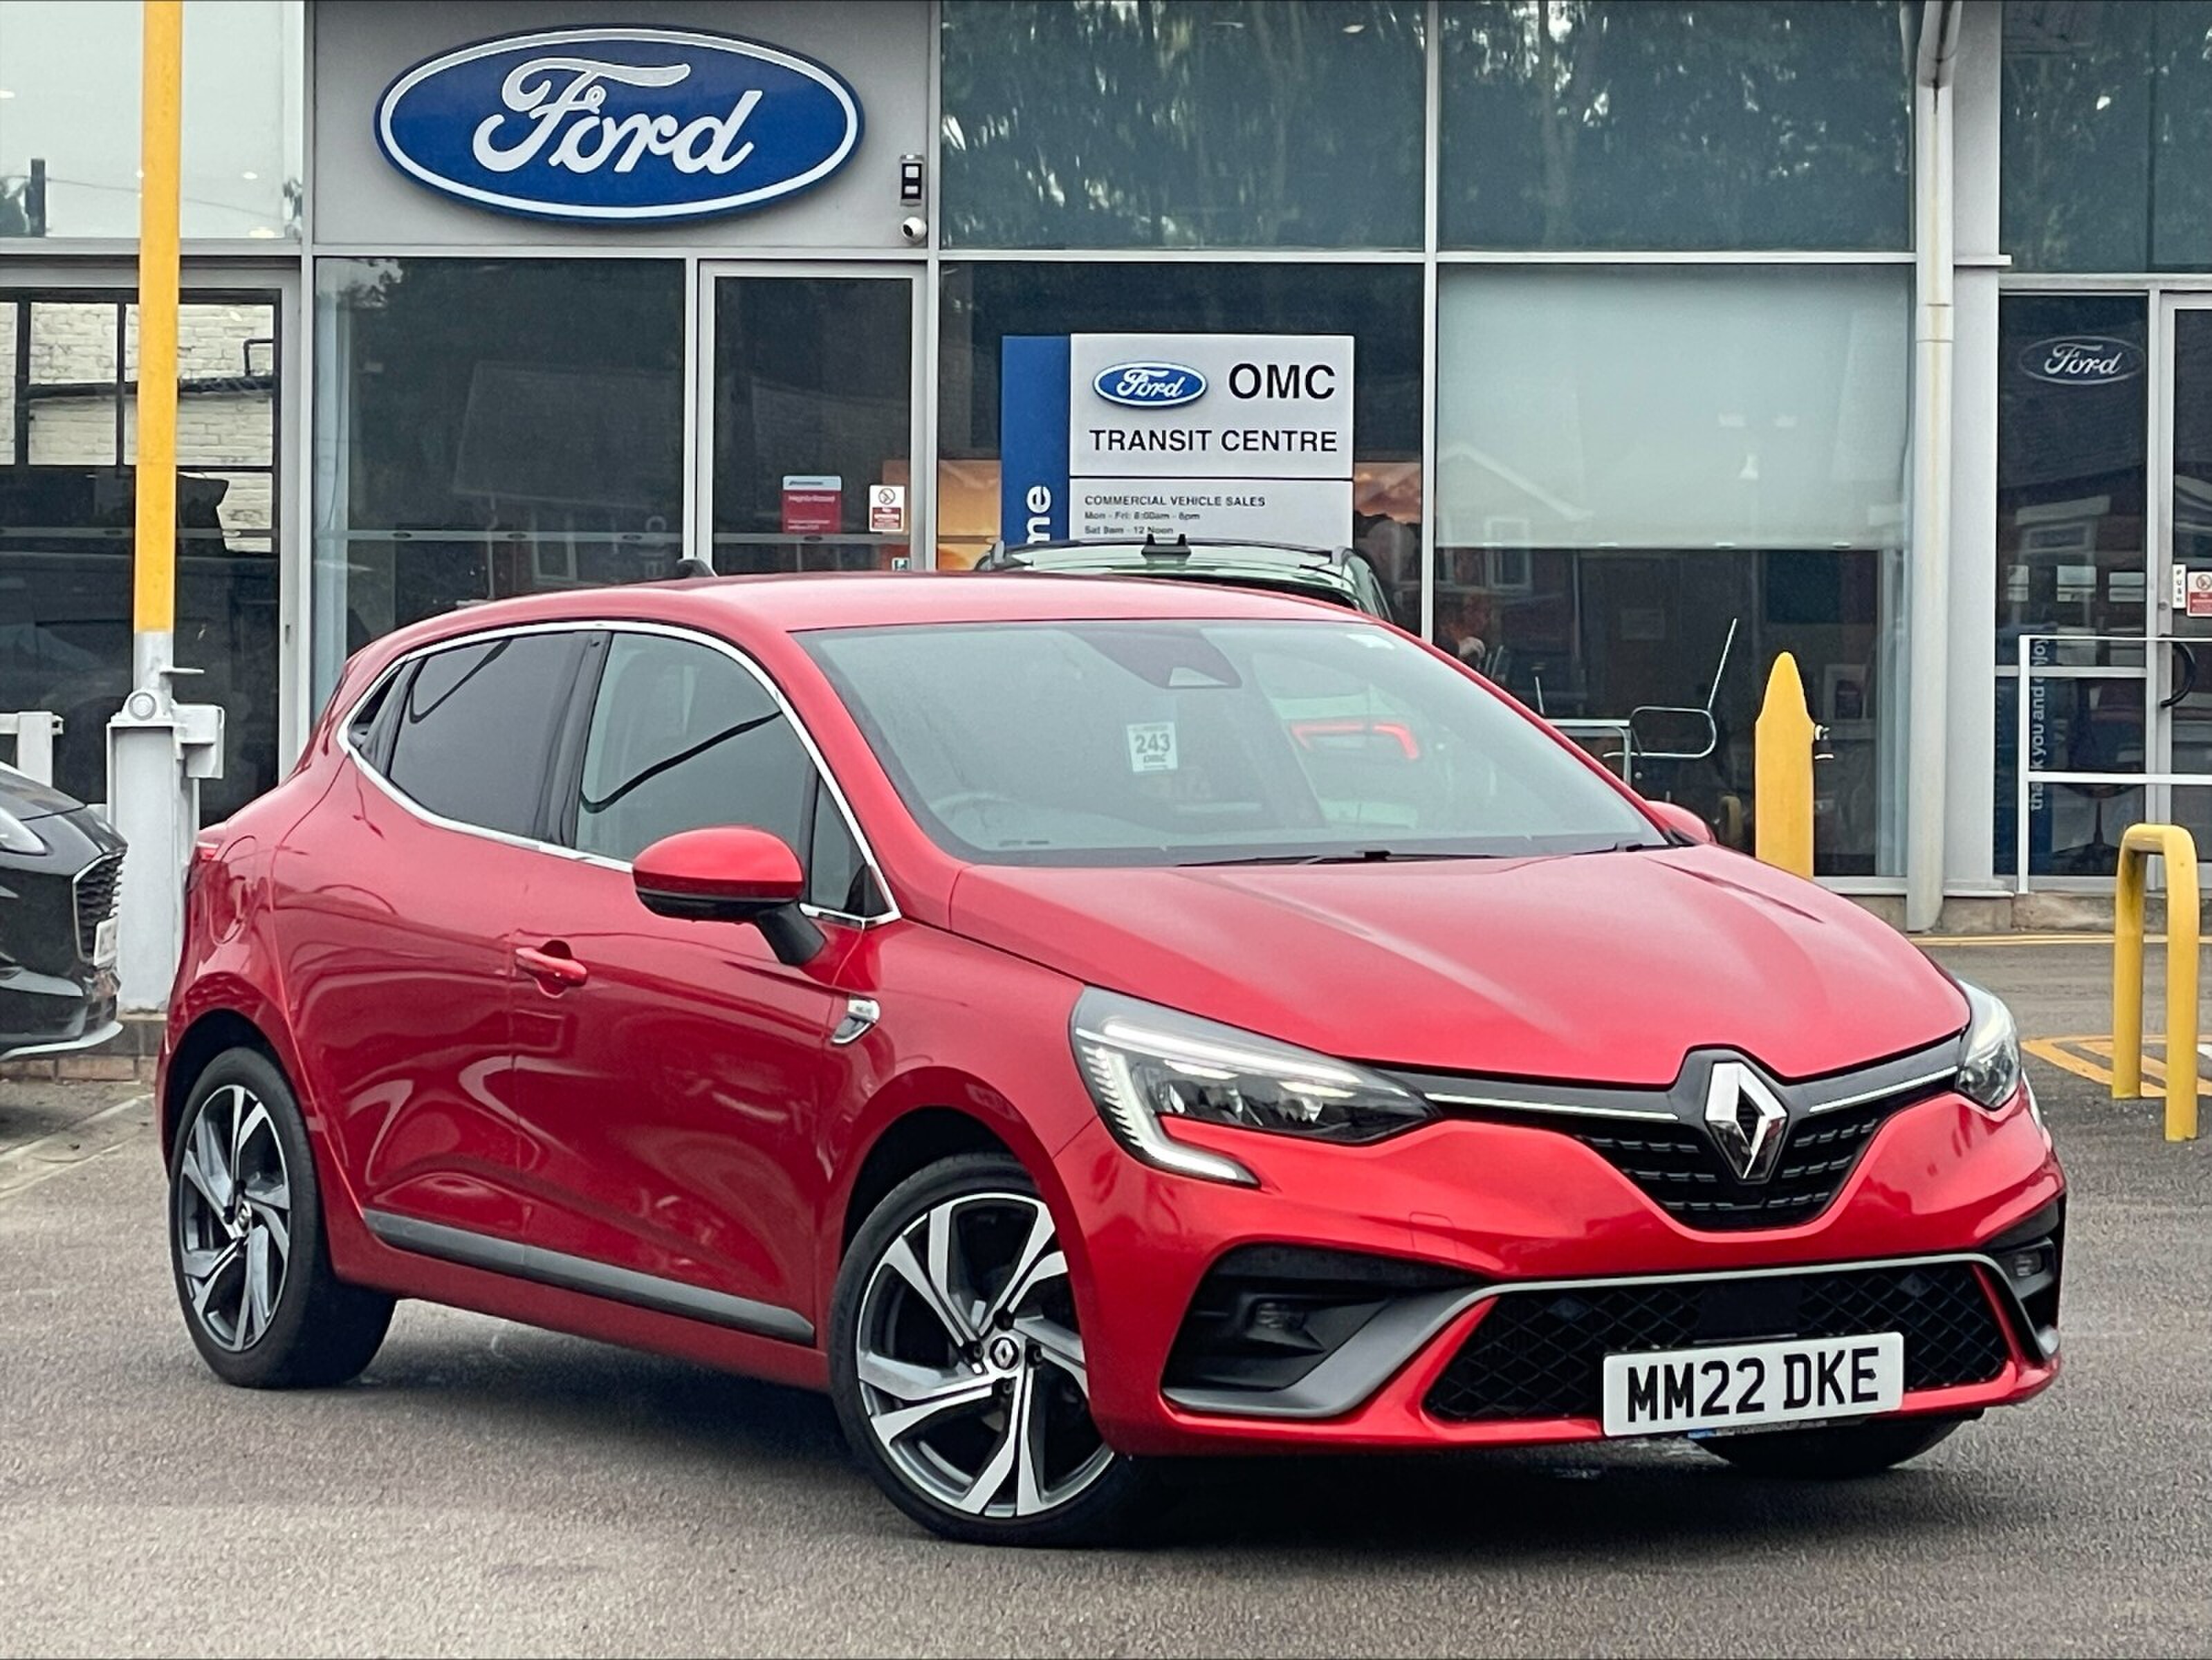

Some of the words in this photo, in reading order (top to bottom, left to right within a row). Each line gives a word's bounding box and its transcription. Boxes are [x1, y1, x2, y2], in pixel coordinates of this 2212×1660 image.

[472, 57, 764, 174] Ford
[2044, 343, 2123, 375] Ford
[1116, 367, 1186, 398] Ford
[1228, 362, 1336, 400] OMC
[1089, 429, 1213, 452] TRANSIT
[1221, 430, 1338, 452] CENTRE
[1084, 495, 1167, 506] COMMERCIAL
[1170, 496, 1222, 506] VEHICLE
[1225, 496, 1266, 507] SALES
[1084, 511, 1106, 520] Mon
[1134, 526, 1145, 535] 12
[1147, 526, 1174, 535] Noon
[2030, 686, 2045, 721] and
[1134, 732, 1171, 754] 243
[2031, 723, 2046, 756] you
[2030, 758, 2044, 811] thak
[1627, 1356, 1766, 1423] MM22
[1782, 1347, 1879, 1410] DKE
